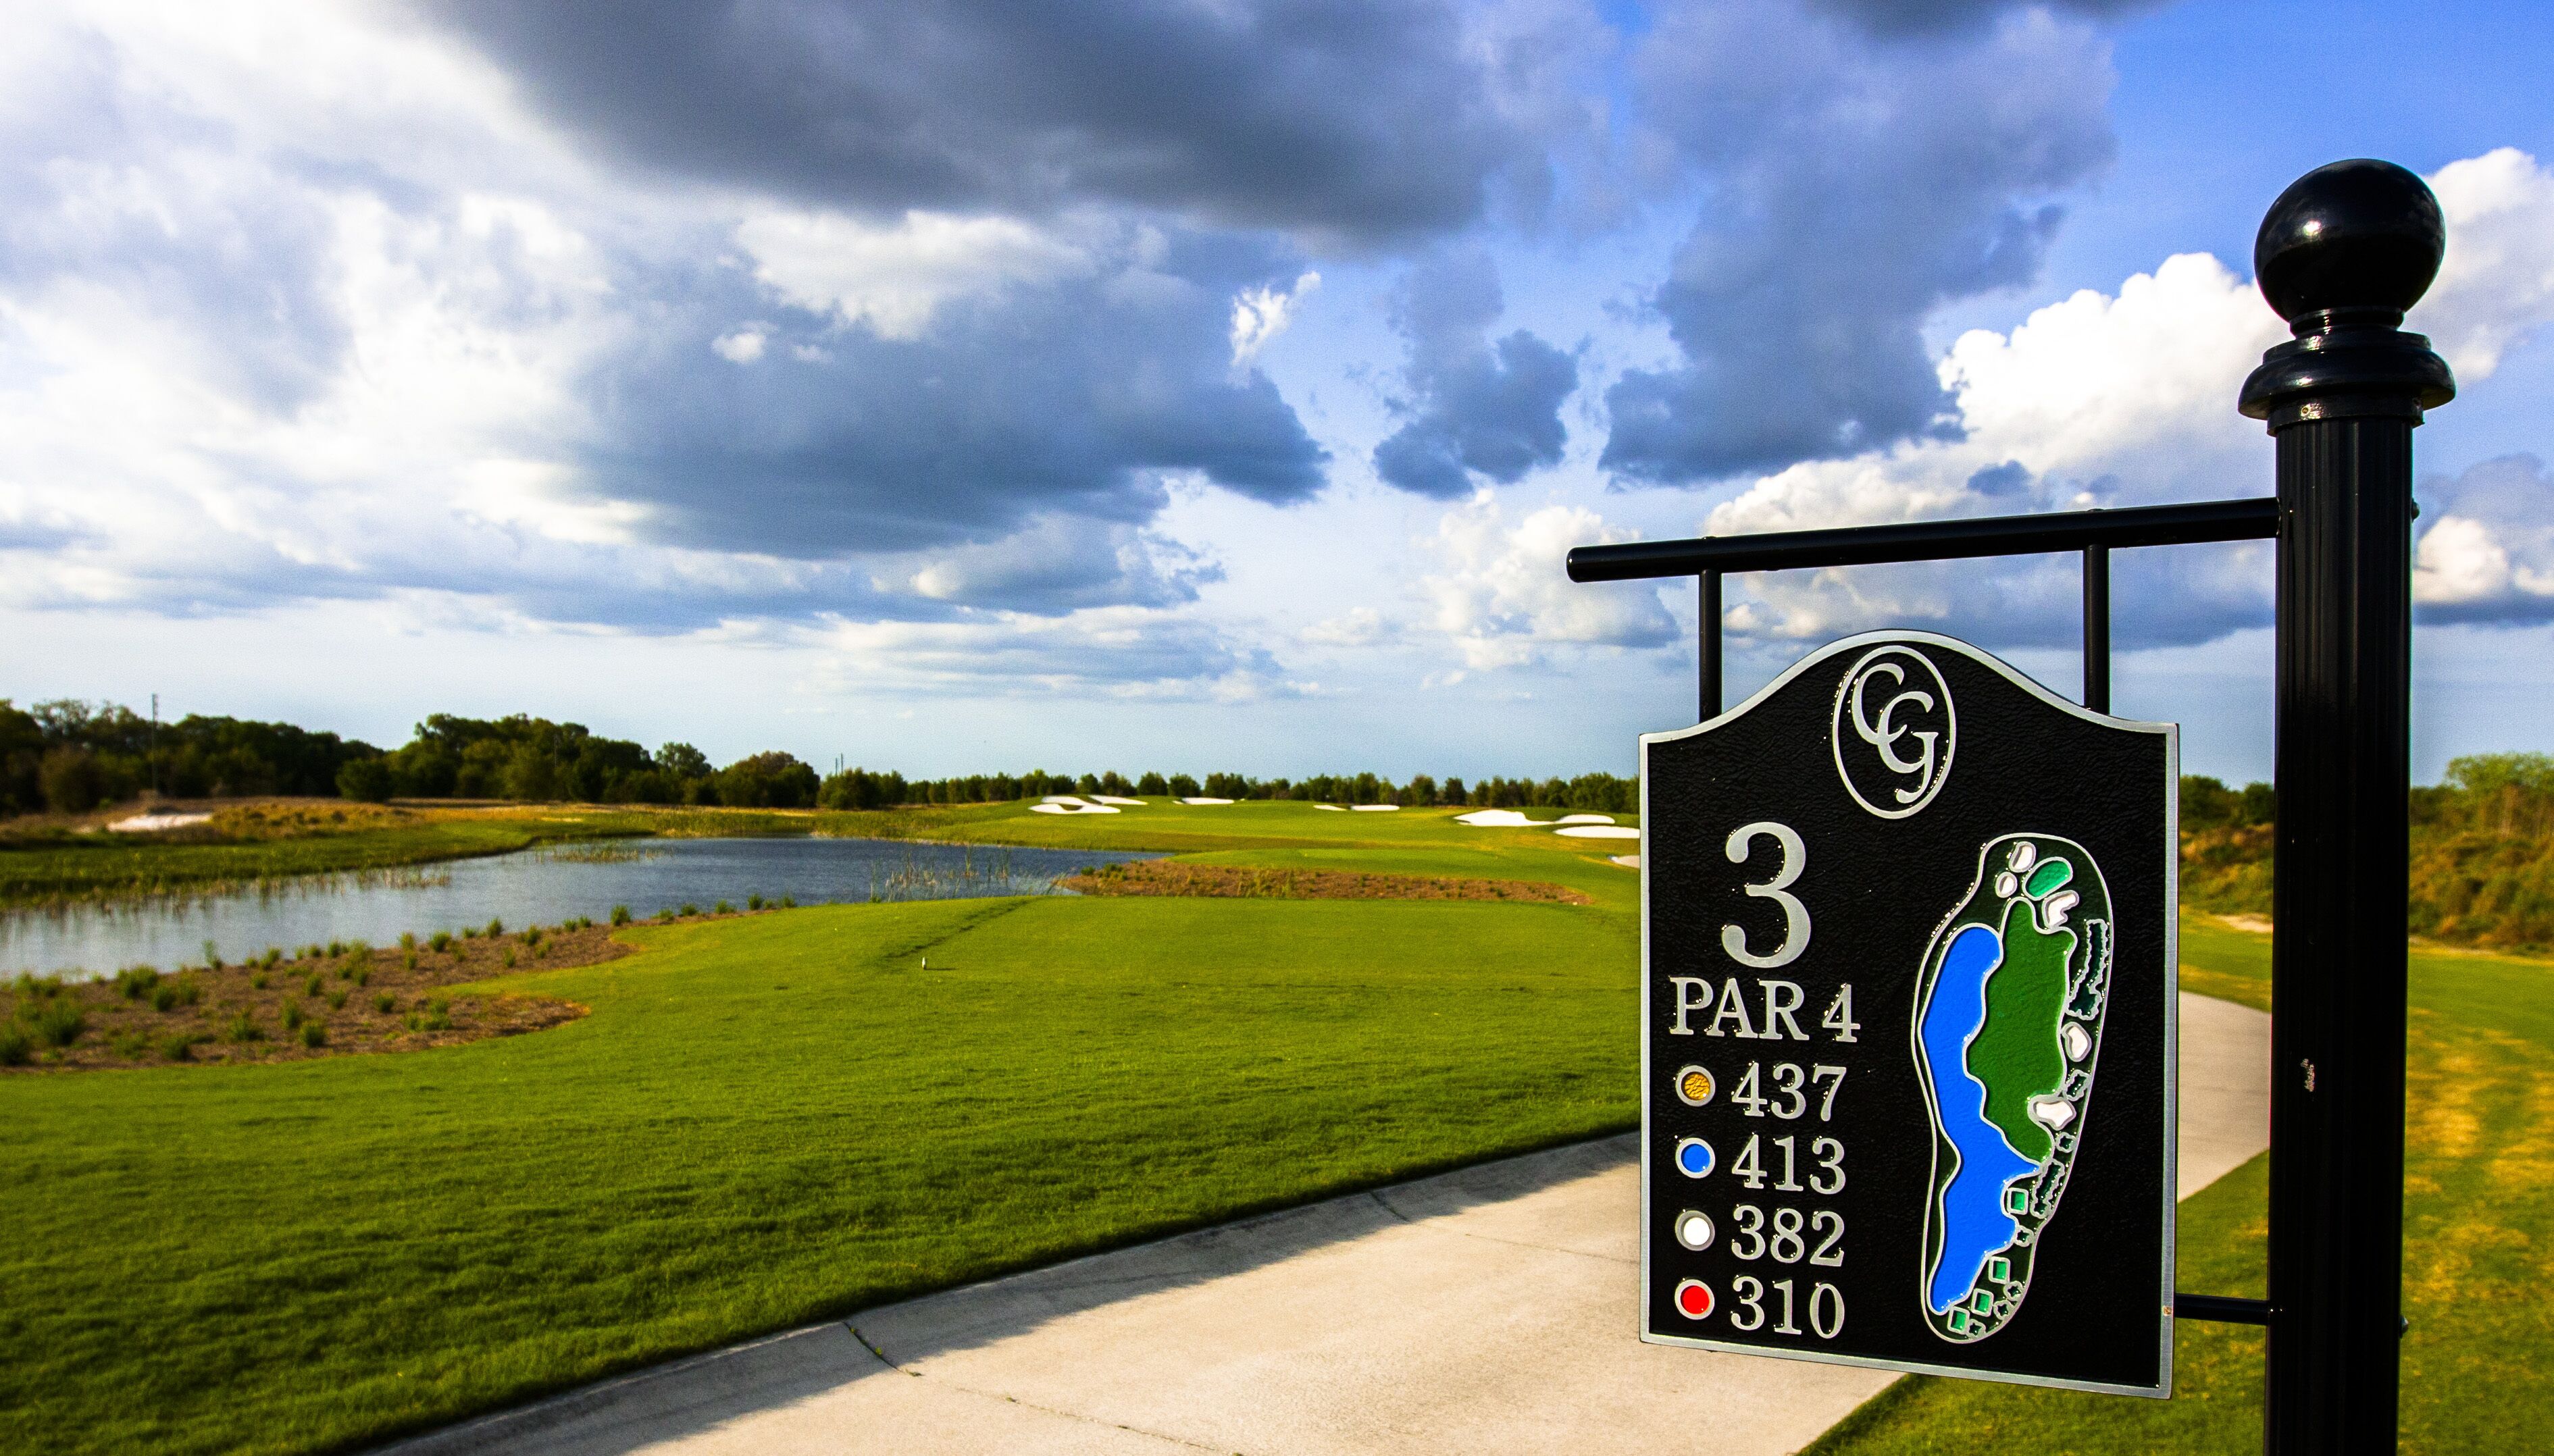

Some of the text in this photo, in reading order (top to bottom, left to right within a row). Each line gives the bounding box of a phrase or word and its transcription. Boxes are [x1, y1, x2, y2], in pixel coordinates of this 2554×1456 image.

[1721, 821, 1811, 968] 3
[1669, 977, 1860, 1043] PAR 4
[1731, 1062, 1847, 1122] 437
[1731, 1135, 1845, 1194] 413
[1731, 1205, 1844, 1267] 382
[1731, 1276, 1845, 1339] 310
